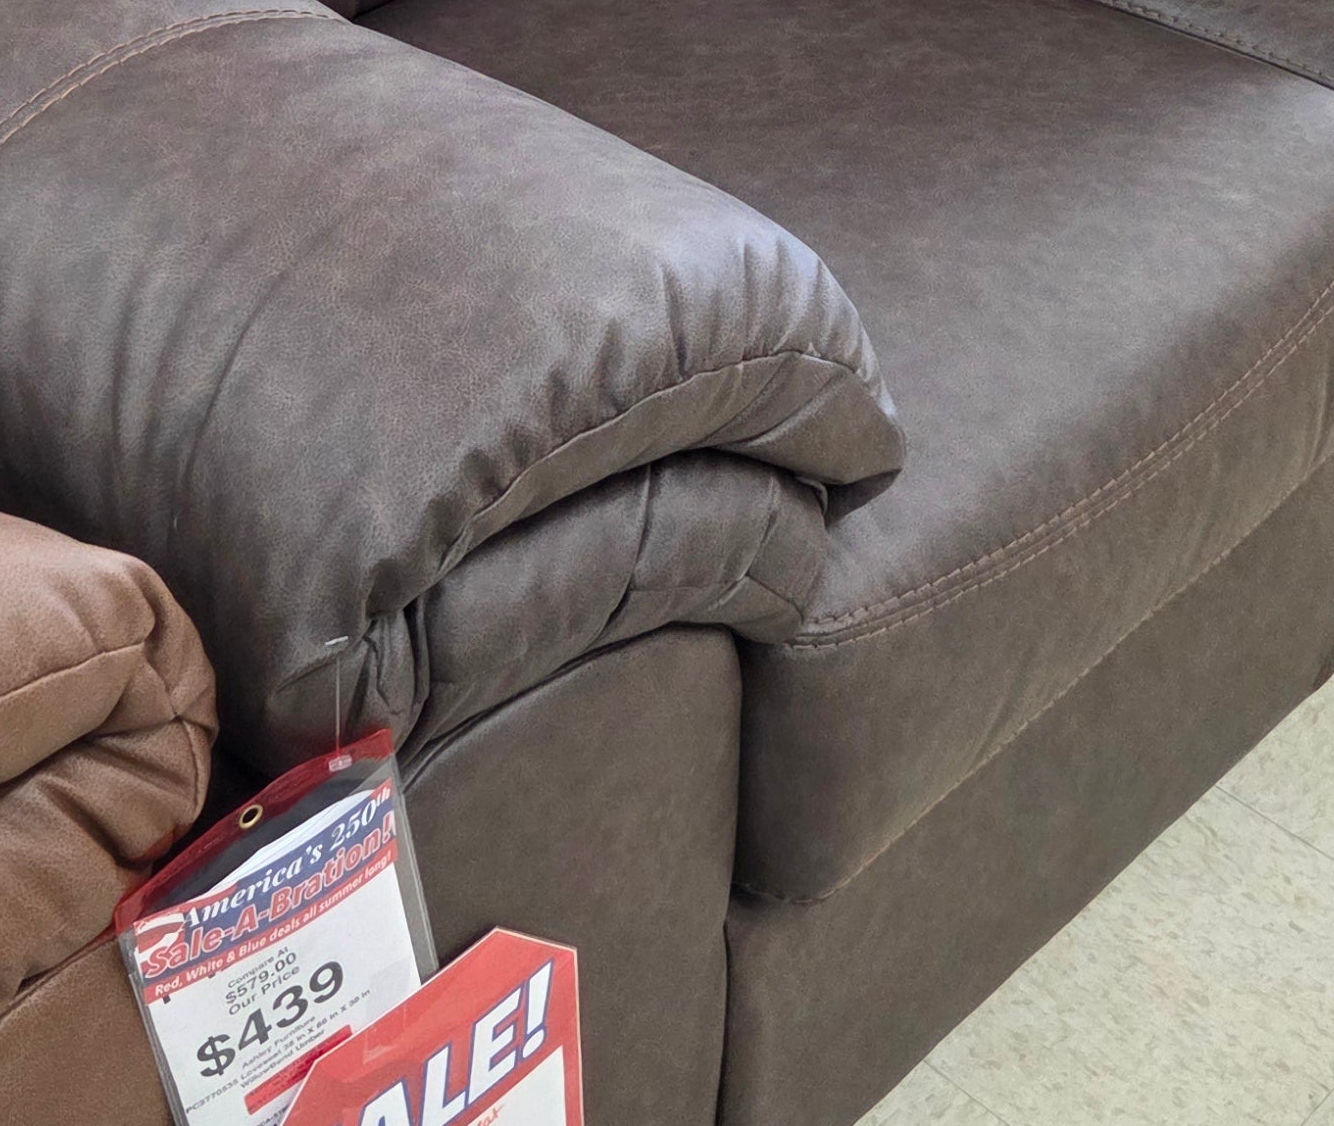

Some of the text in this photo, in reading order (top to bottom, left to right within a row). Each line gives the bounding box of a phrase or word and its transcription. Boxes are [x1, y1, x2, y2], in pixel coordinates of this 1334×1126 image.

[145, 811, 395, 978] Sale-A-Bration!
[183, 786, 392, 927] America's 250th
[155, 851, 392, 998] Red, White & Blue deals all summer long!
[225, 952, 297, 1004] $579.00
[228, 956, 274, 988] Compare
[196, 960, 344, 1077] $439
[228, 965, 300, 1015] Our Price
[242, 1016, 315, 1069] Ashley Furniture
[359, 958, 554, 1126] ALE!
